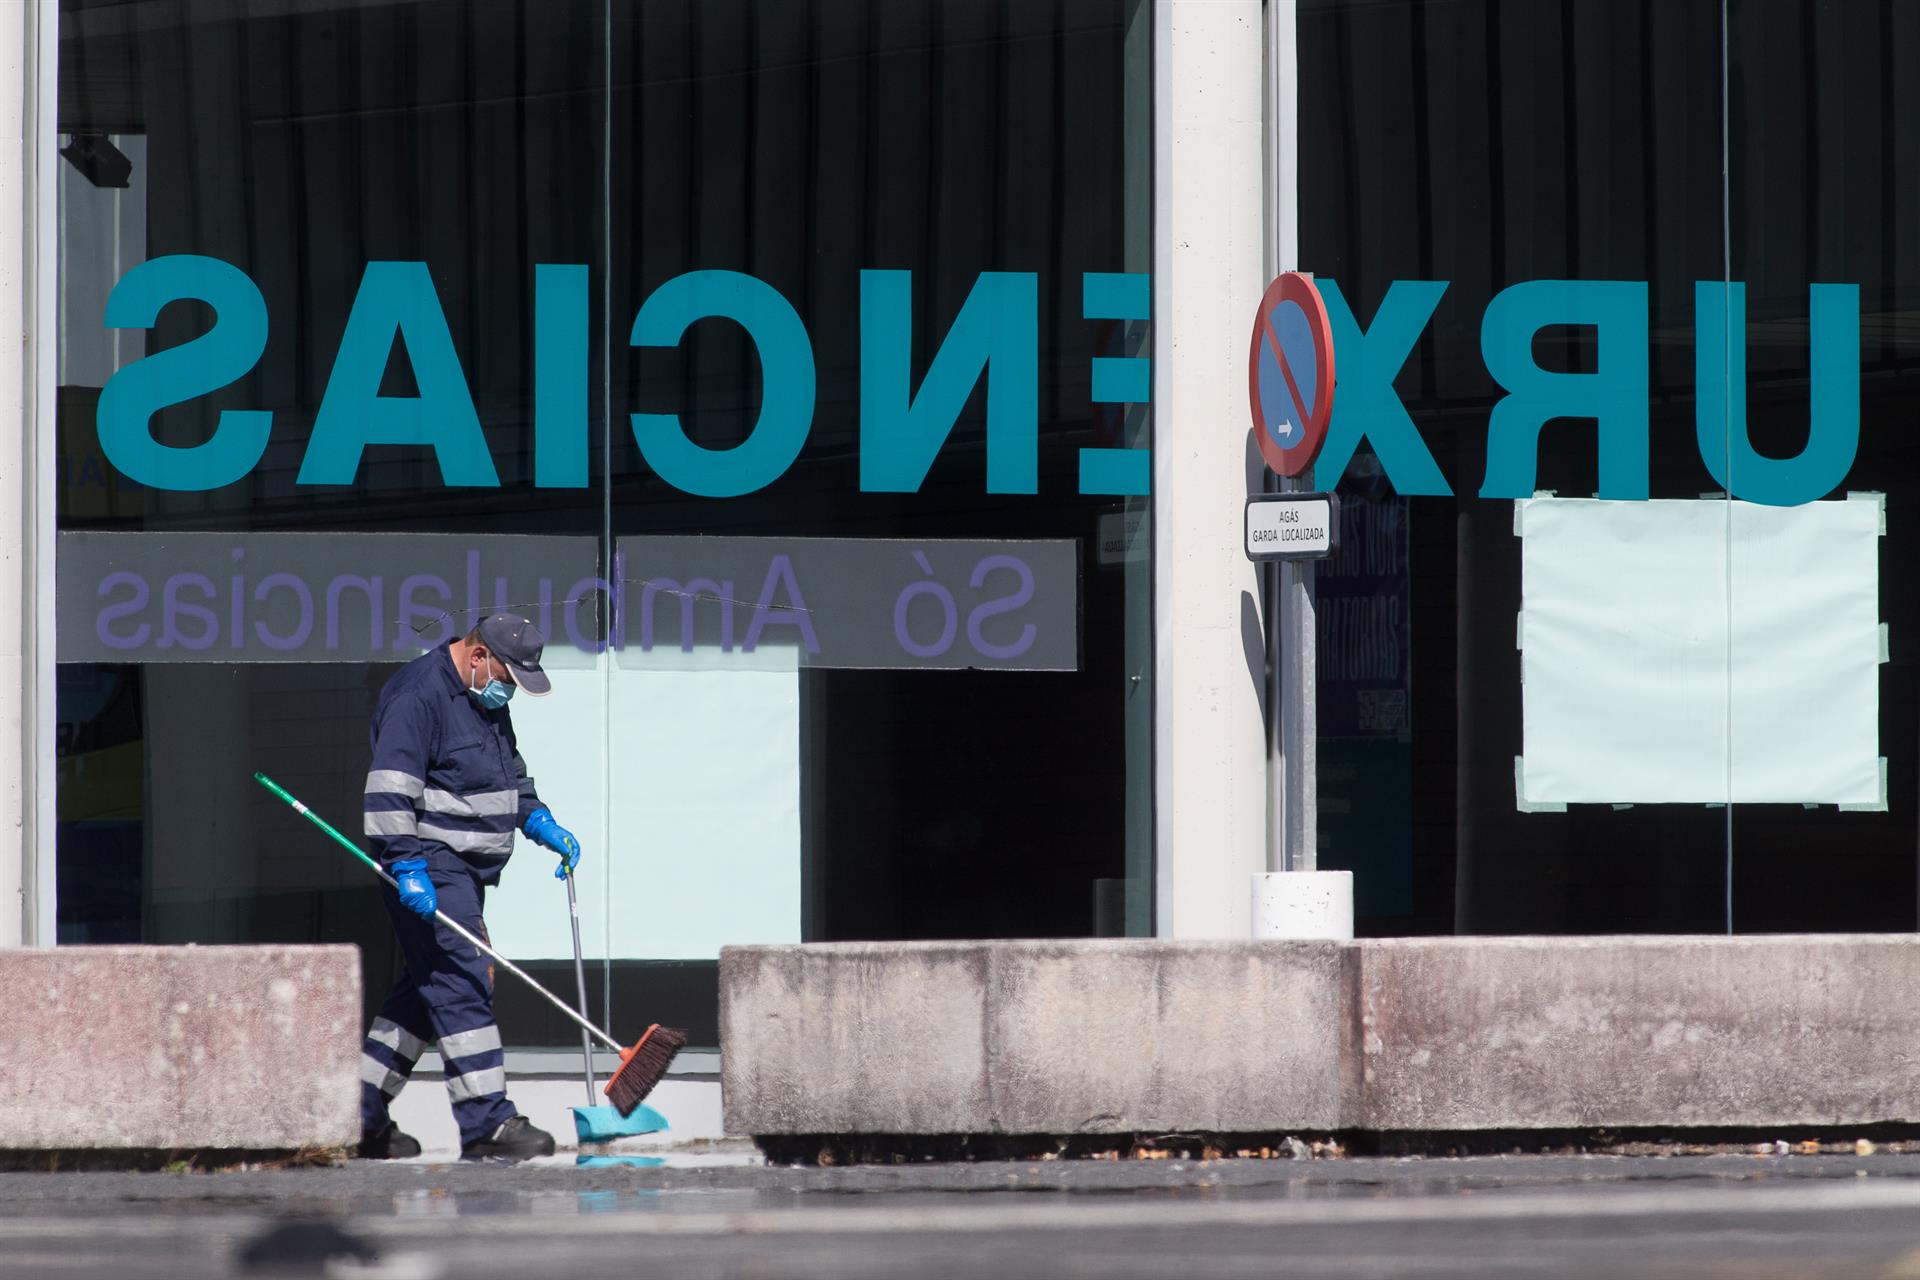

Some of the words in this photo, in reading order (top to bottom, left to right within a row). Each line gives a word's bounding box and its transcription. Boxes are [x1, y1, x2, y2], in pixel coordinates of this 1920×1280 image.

[1279, 508, 1299, 523] AGÁS
[1253, 530, 1278, 542] GARDA
[1281, 528, 1324, 541] LOCALIZADA
